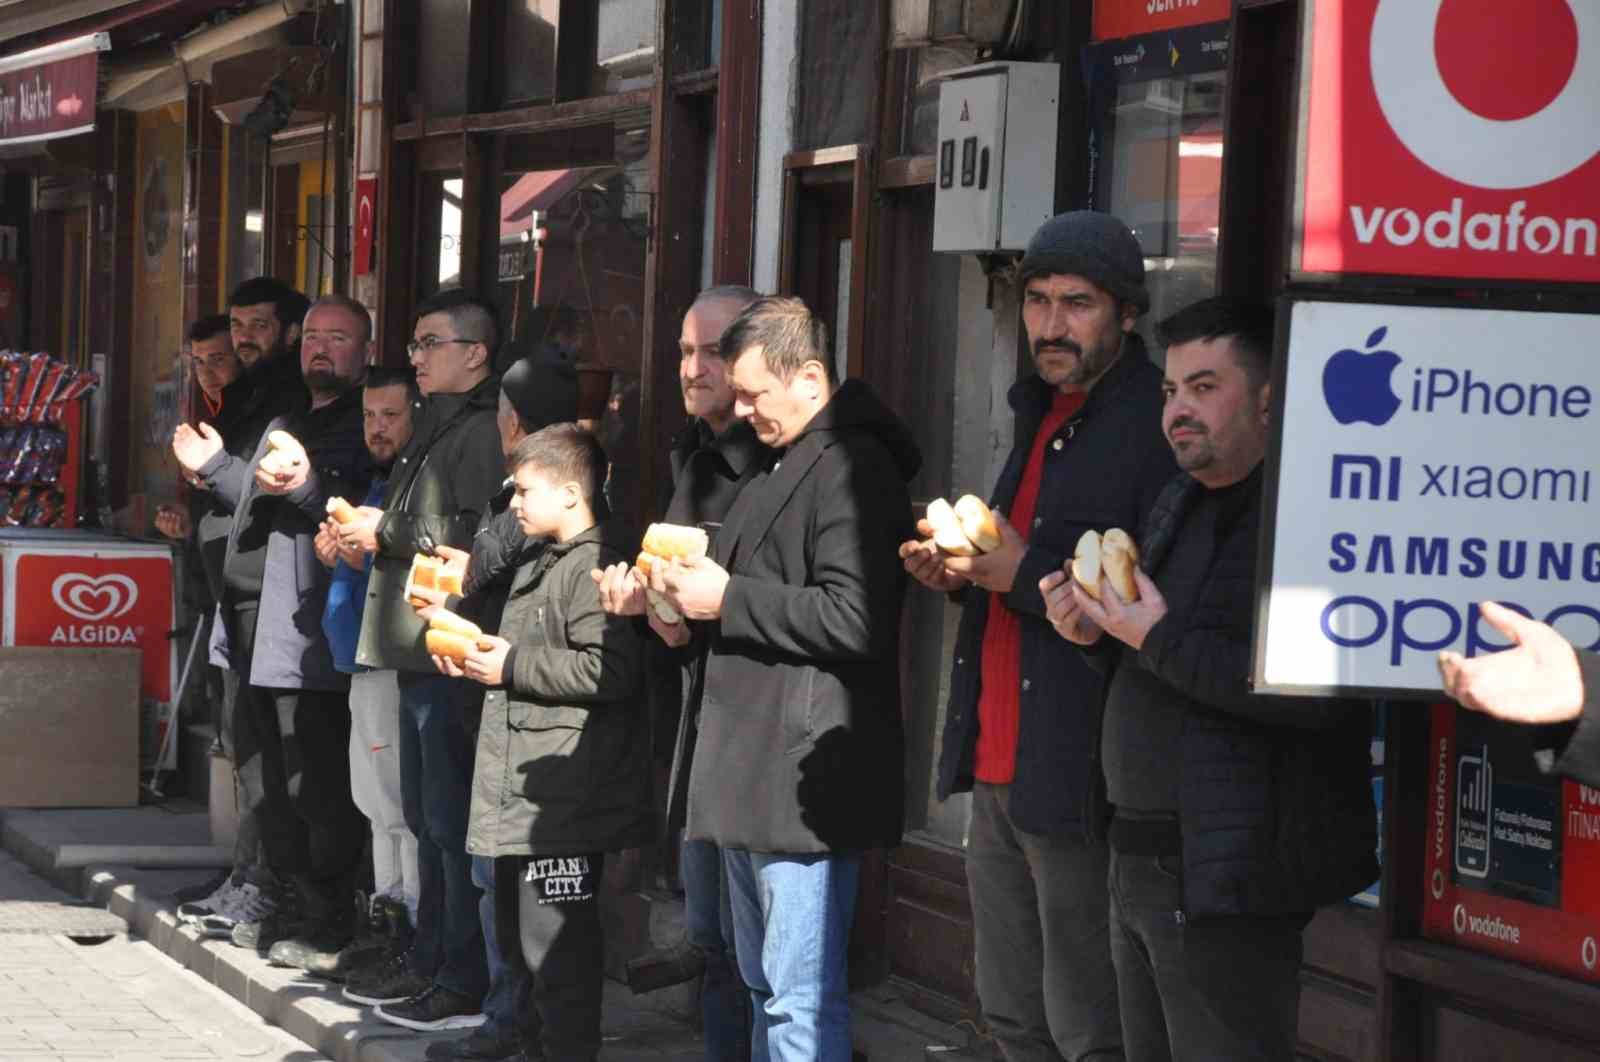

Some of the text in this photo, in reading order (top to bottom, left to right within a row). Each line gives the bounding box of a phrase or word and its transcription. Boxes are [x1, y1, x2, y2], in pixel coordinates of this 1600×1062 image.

[1411, 368, 1592, 418] iPhone
[1418, 463, 1591, 503] xiaomi
[1328, 532, 1600, 583] SAMSUNG
[545, 875, 583, 895] CITY
[1468, 913, 1521, 944] vodafone
